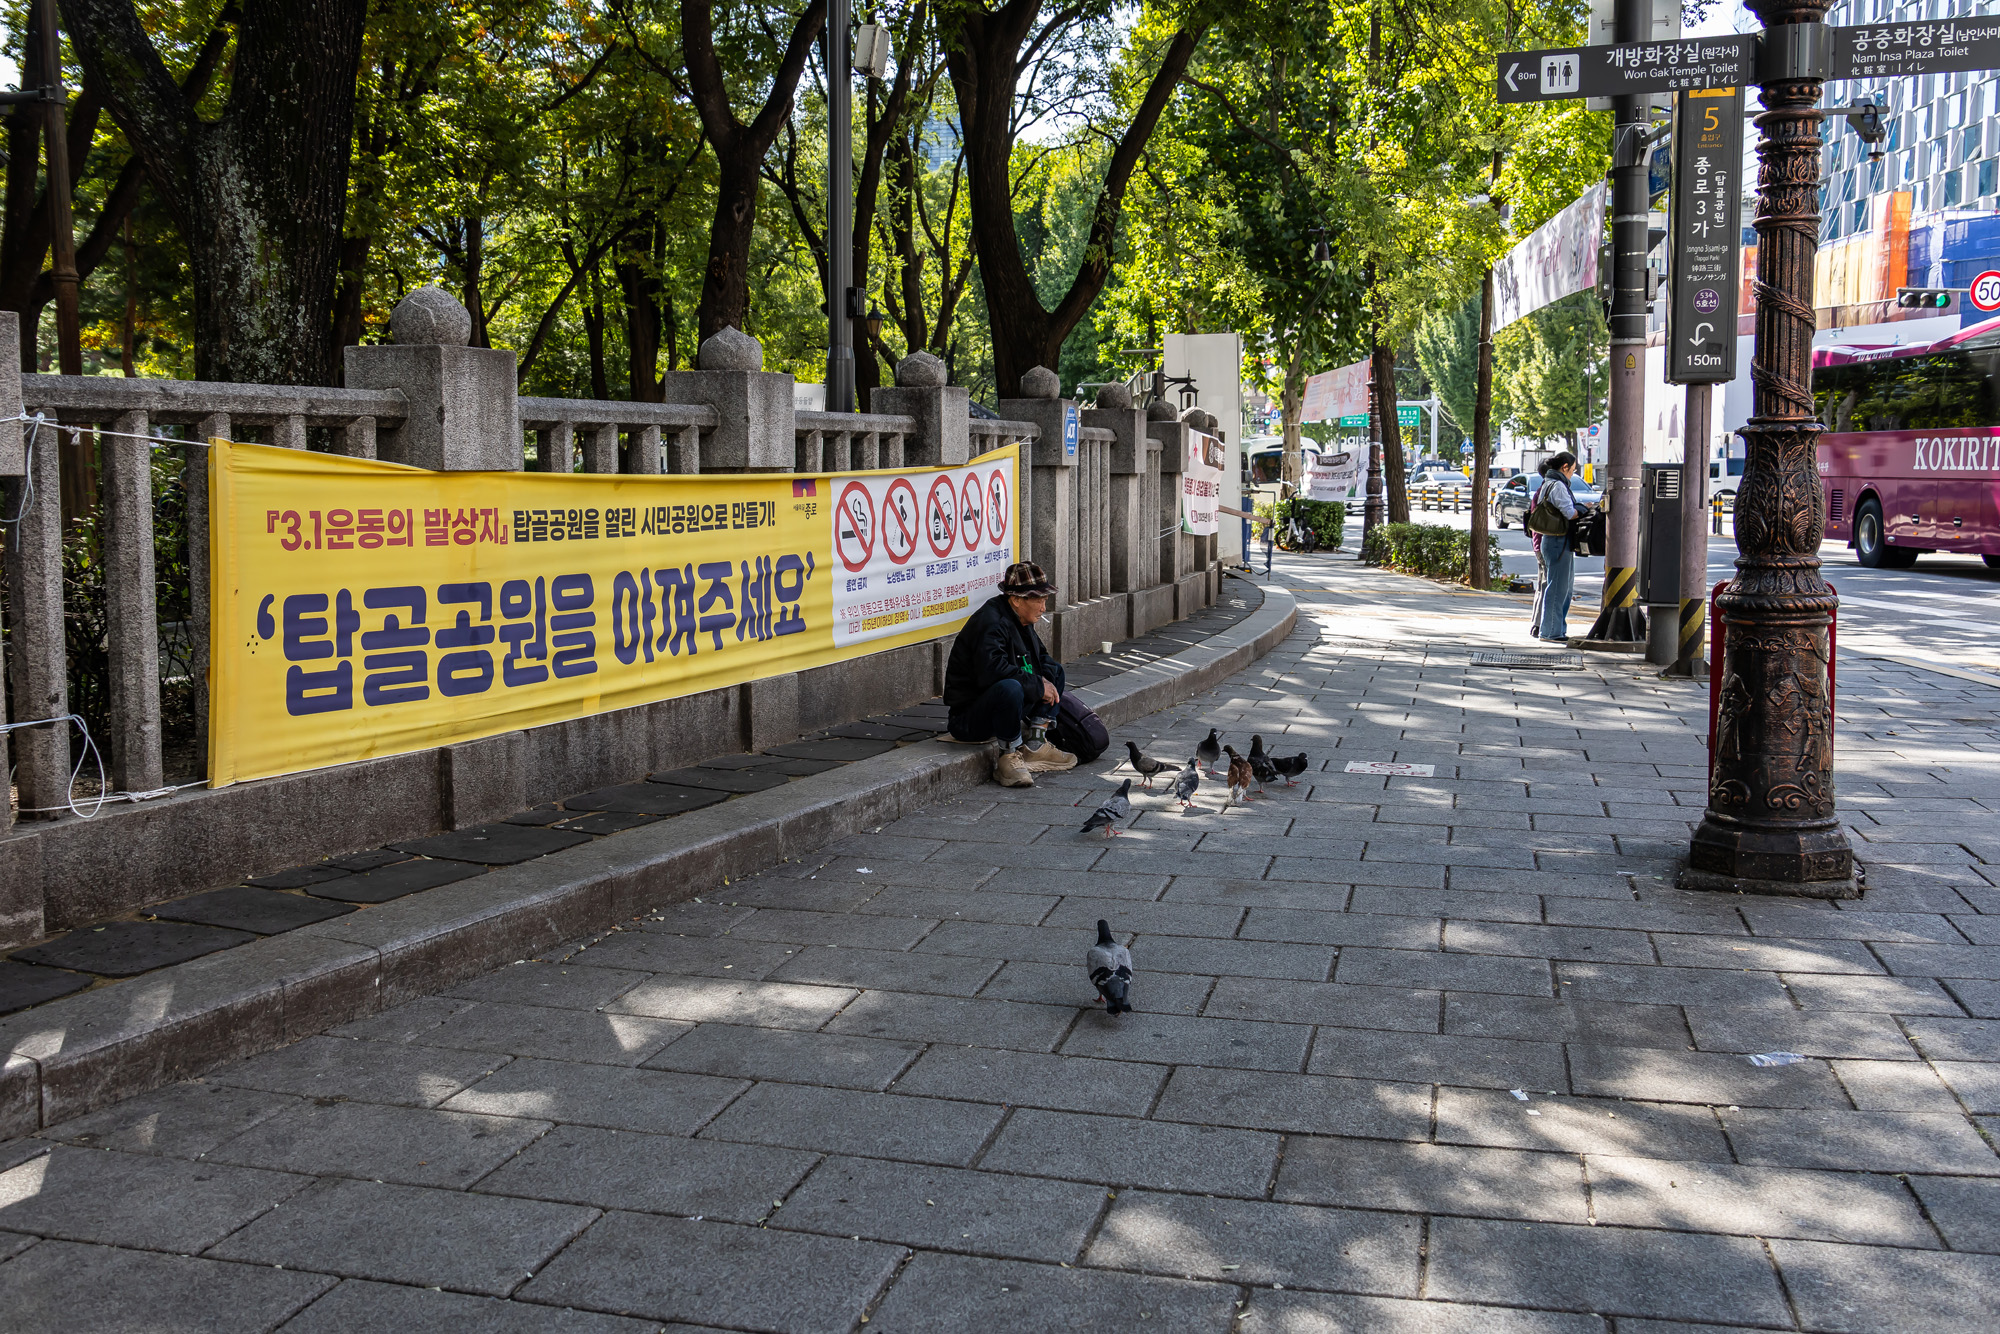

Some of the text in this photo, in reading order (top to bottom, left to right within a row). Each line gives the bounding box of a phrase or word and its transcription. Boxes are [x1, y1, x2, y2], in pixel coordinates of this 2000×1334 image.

[1852, 47, 1969, 63] Nam Insa Plaza Toilet
[1518, 72, 1537, 80] 80m
[1624, 69, 1647, 80] Won
[1709, 63, 1738, 73] Toilet
[1703, 106, 1719, 131] 5
[1701, 133, 1721, 142] 출입구
[1691, 156, 1712, 239] 종로3가
[1713, 170, 1727, 228] (탑골공원)
[1686, 245, 1704, 255] Jongno
[1686, 273, 1727, 281] チョンノサンガ
[1978, 281, 2000, 301] 50
[1696, 299, 1717, 308] 5호선
[1687, 354, 1722, 366] 150m
[804, 502, 817, 520] 종로
[267, 500, 775, 551] 『3.1운동의 발상지』 탑골공원을 열린 시민공원으로 만들기!
[906, 568, 916, 581] 금지
[857, 577, 868, 590] 금지
